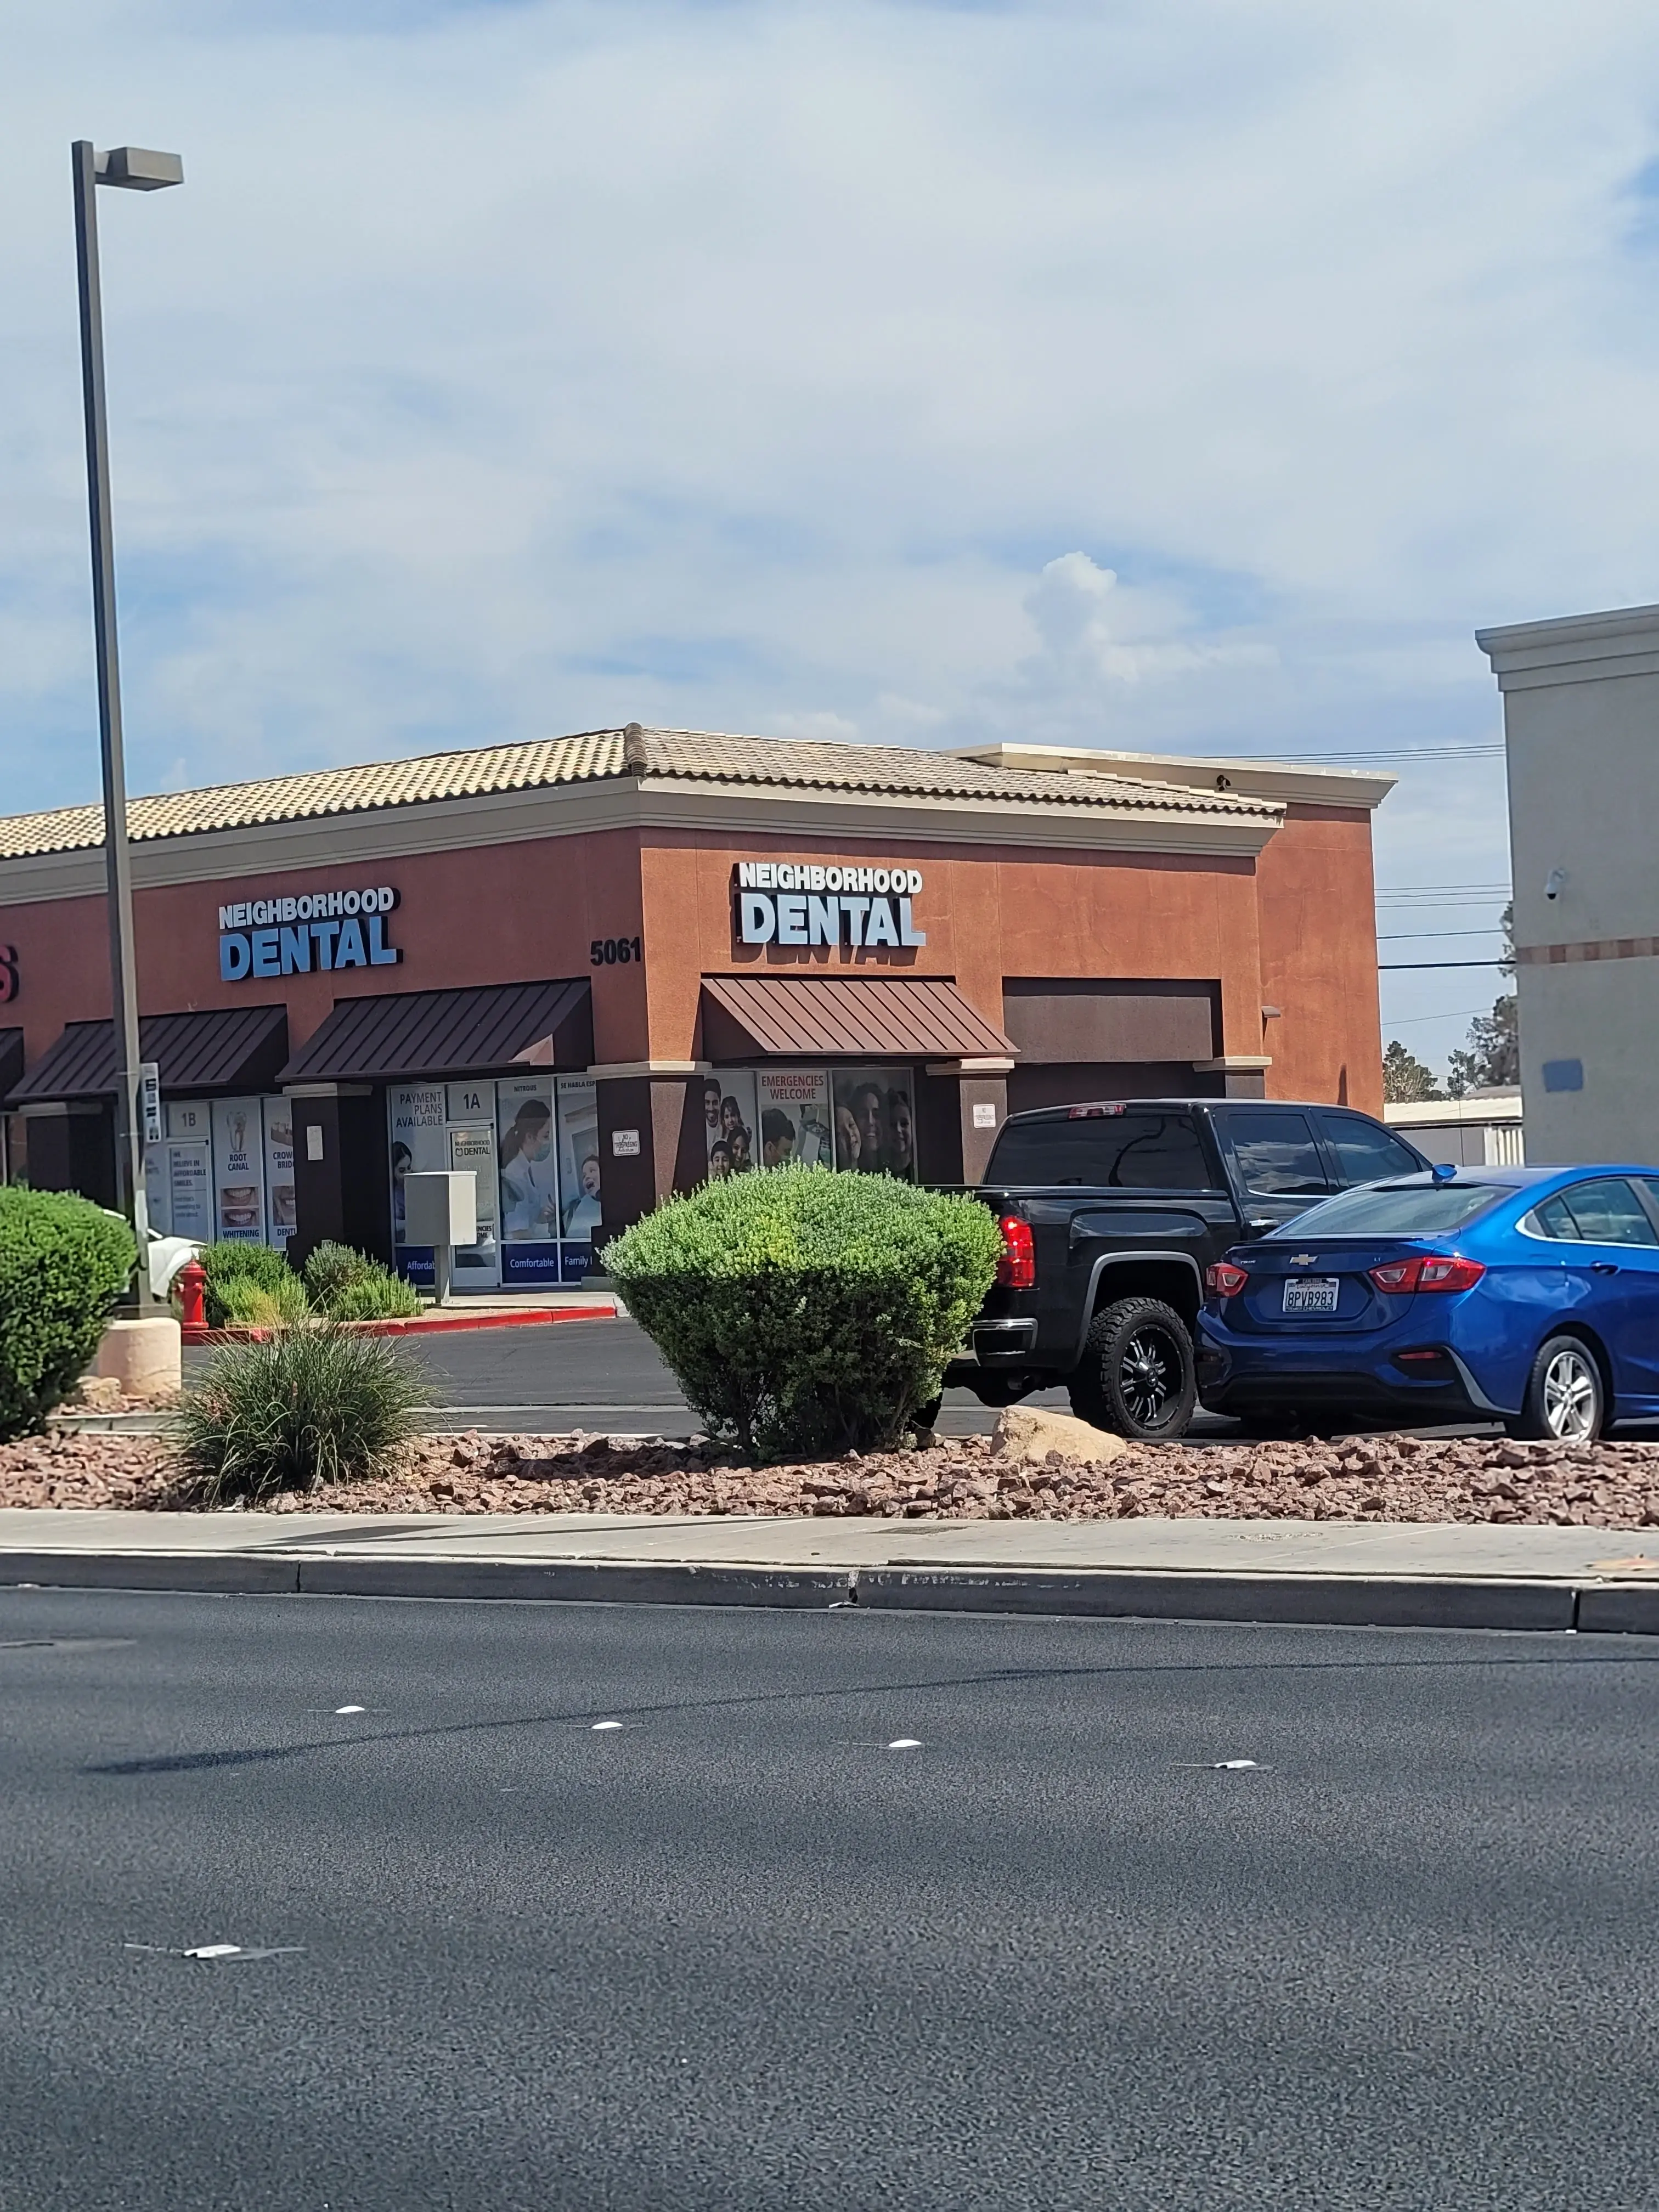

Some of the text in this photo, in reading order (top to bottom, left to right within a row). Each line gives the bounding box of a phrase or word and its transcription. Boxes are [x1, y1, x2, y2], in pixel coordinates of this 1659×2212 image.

[739, 861, 923, 894] NEIGHBORHOOD
[219, 887, 394, 929] NEIGHBORHOOD
[741, 892, 926, 946] DENTAL
[219, 916, 397, 981] DENTAL
[590, 937, 641, 966] 5061
[761, 1075, 823, 1087] EMERGENCIES
[400, 1092, 441, 1105] PAYMENT
[770, 1088, 816, 1100] WELCOME
[463, 1093, 481, 1109] 1A
[414, 1103, 442, 1115] PLANS
[182, 1113, 196, 1127] 1B
[396, 1115, 443, 1128] AVAILABLE
[229, 1154, 246, 1162] ROOT
[464, 1147, 490, 1156] DENTAL
[228, 1163, 249, 1171] CANAL
[223, 1229, 259, 1238] WHITENING
[510, 1258, 554, 1268] Comfortable
[565, 1256, 589, 1267] Family
[1288, 1291, 1334, 1307] 8PVB983
